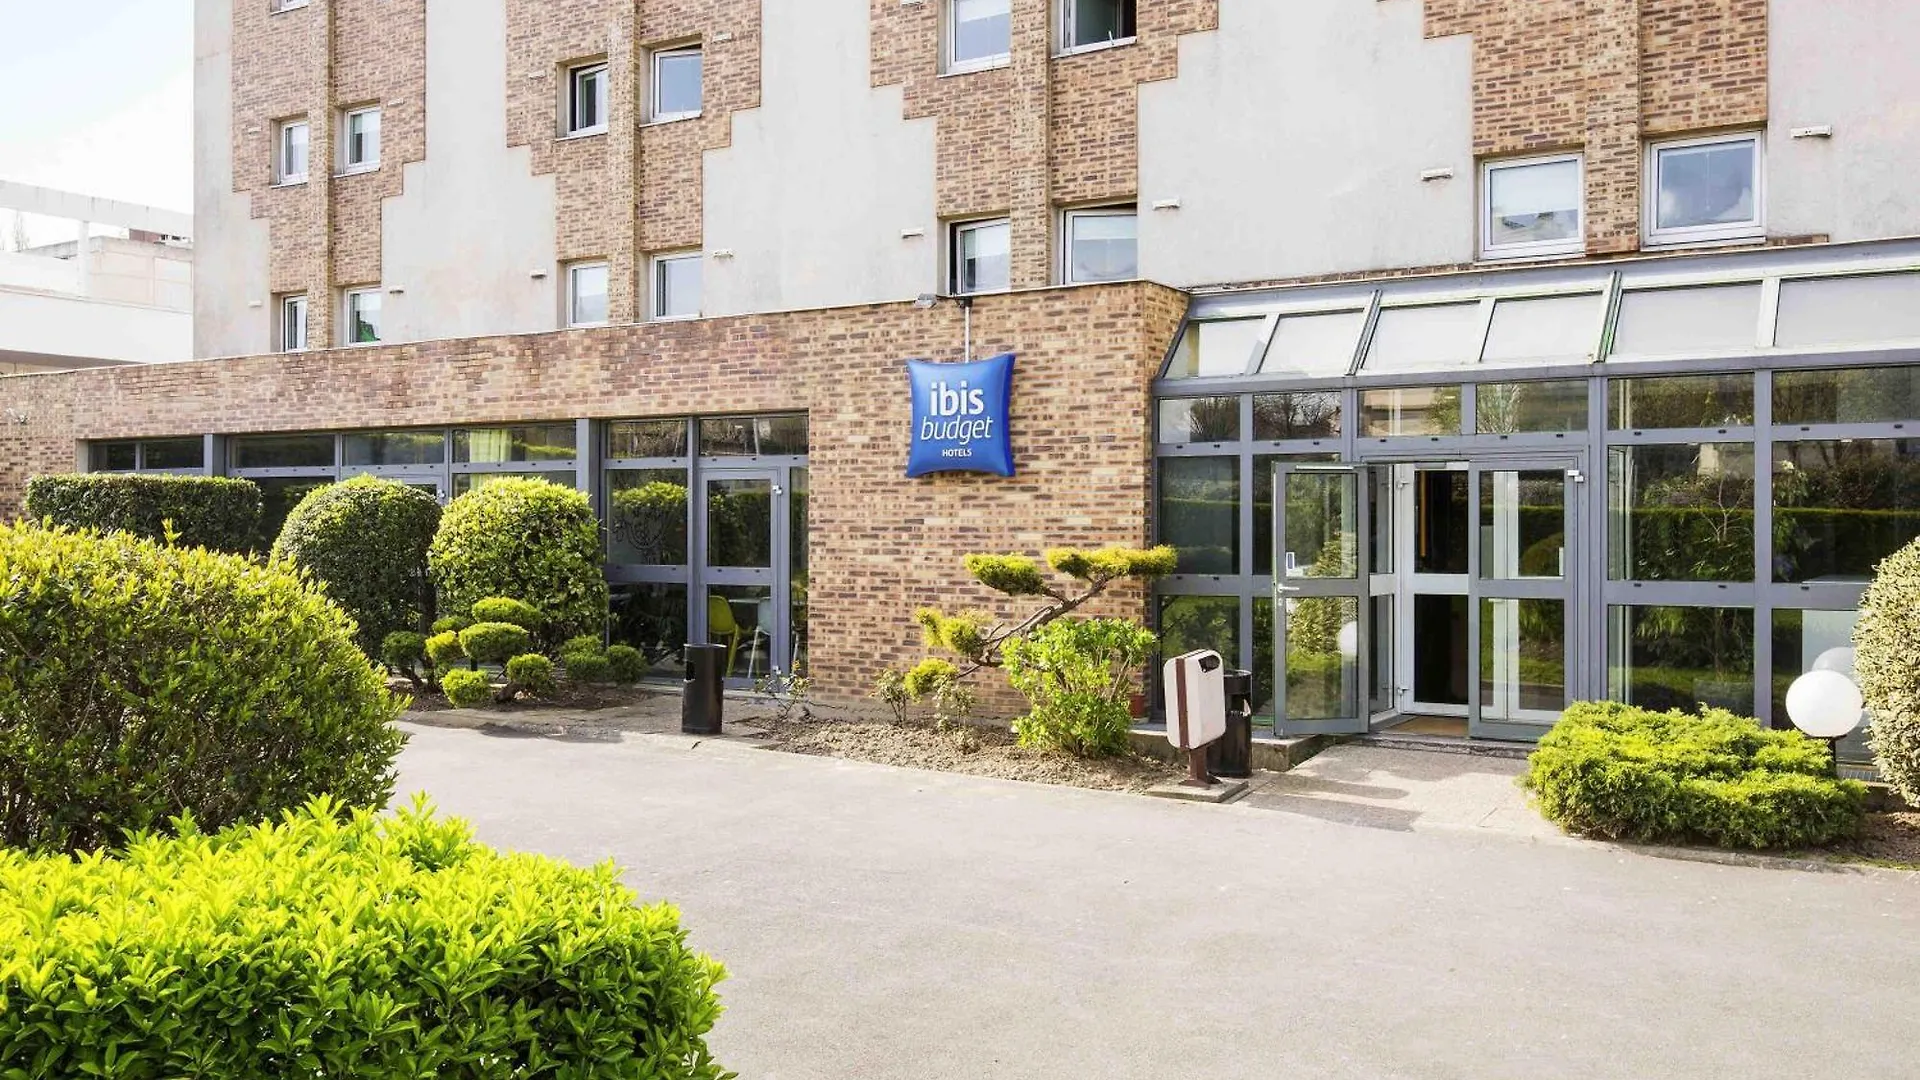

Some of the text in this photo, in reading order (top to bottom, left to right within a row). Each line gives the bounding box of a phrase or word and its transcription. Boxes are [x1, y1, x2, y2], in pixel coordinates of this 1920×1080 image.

[930, 380, 984, 416] ibis
[920, 415, 993, 445] budget
[942, 448, 972, 457] HOTELS
